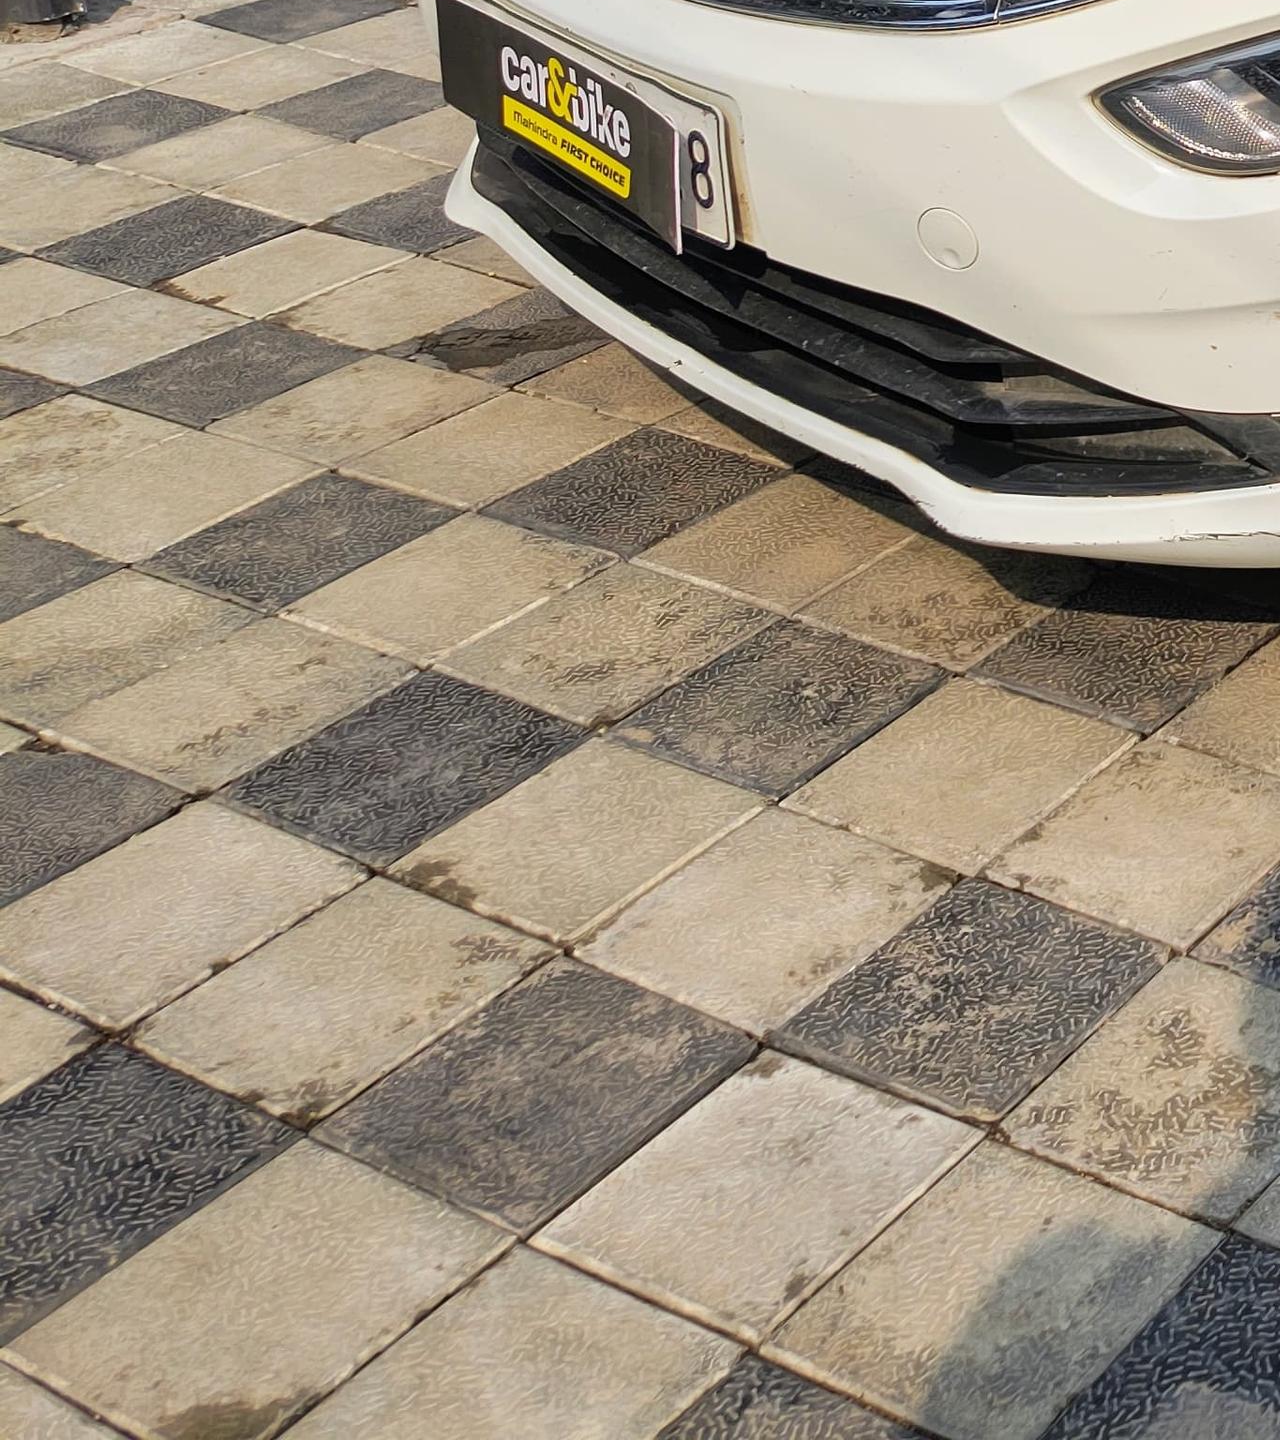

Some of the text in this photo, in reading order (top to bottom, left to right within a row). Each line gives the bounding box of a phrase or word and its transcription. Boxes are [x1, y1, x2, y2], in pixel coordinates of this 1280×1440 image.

[501, 46, 631, 158] car&bike
[560, 138, 589, 164] FIRST
[590, 156, 626, 188] CHOICE
